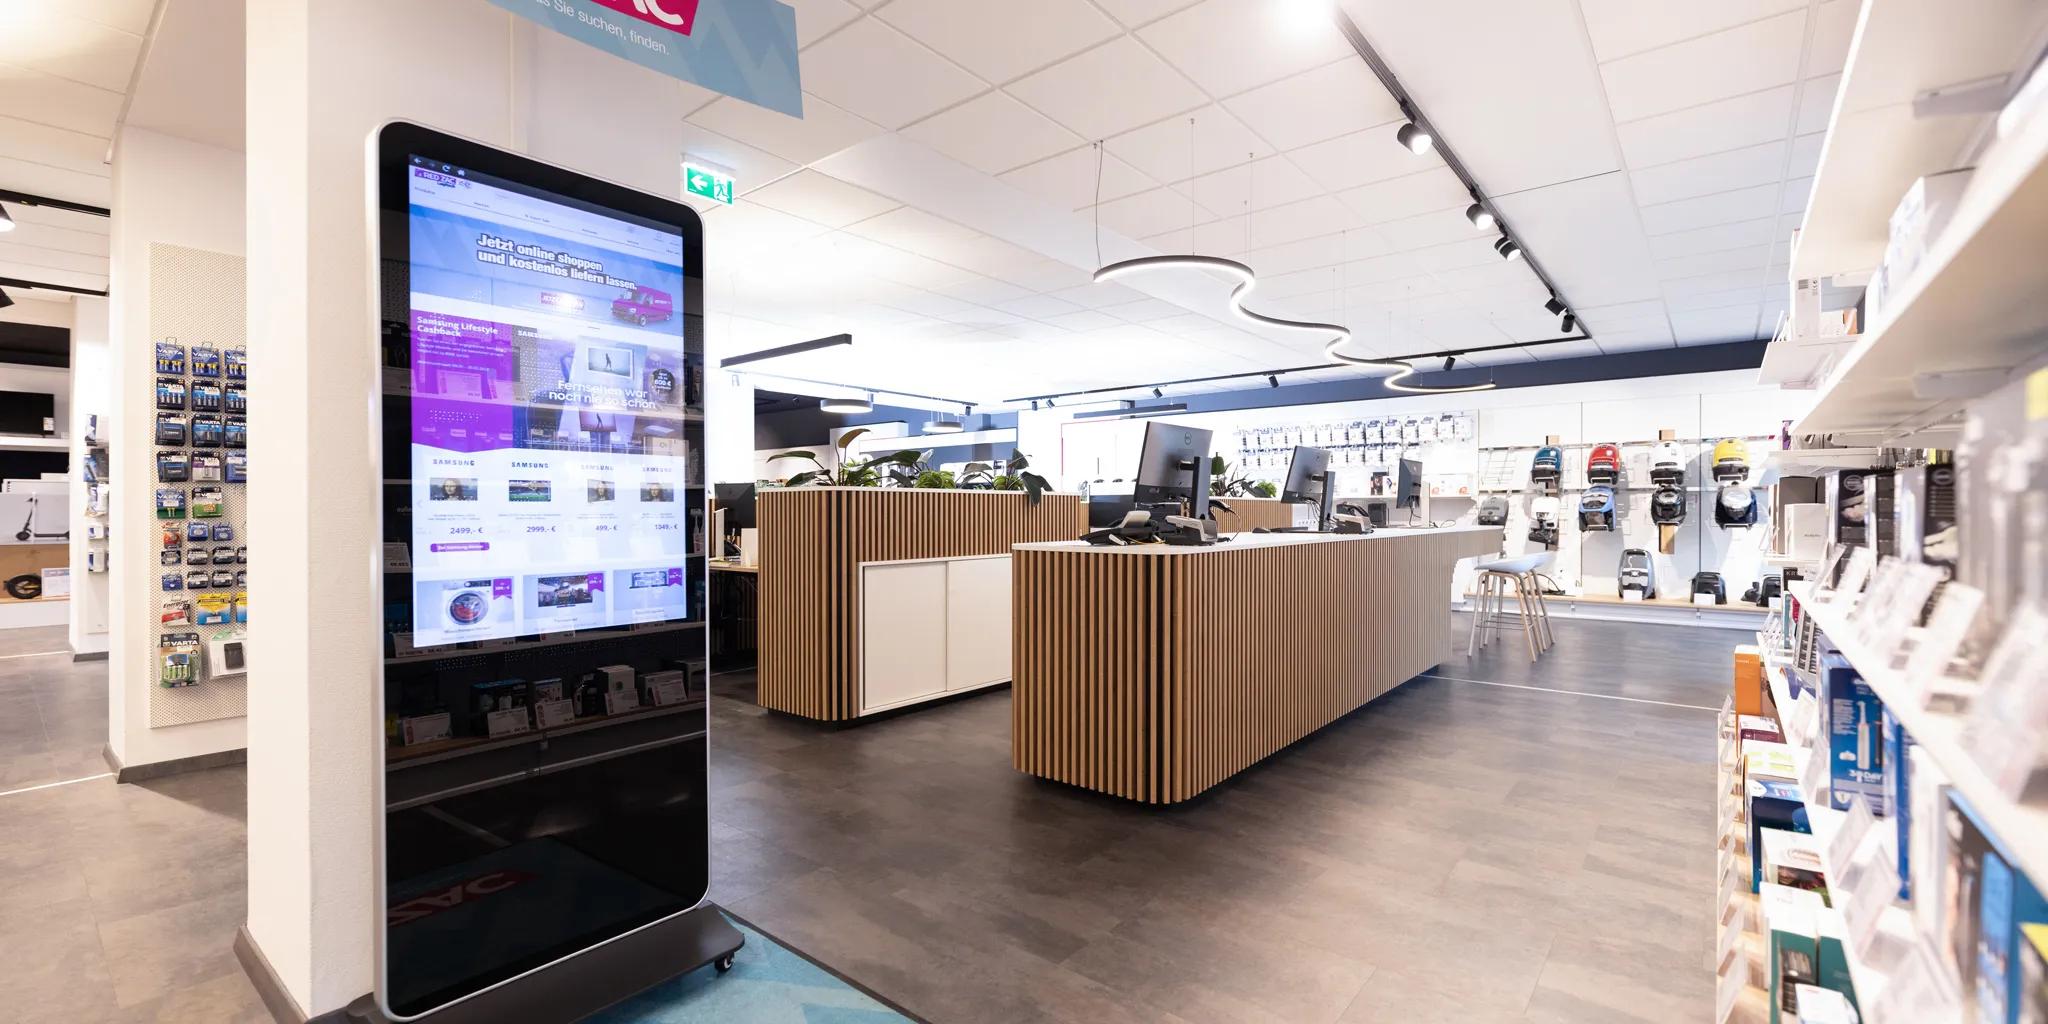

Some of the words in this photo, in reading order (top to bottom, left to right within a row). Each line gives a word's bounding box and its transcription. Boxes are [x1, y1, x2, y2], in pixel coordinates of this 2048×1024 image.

[554, 0, 575, 17] Sie
[578, 9, 627, 41] suchen,
[629, 29, 670, 55] finden.
[477, 234, 514, 252] Jetzt
[516, 244, 555, 261] online
[557, 253, 603, 272] shoppen
[478, 250, 506, 265] und
[509, 254, 569, 277] kostenlos
[570, 268, 604, 284] liefern
[605, 275, 638, 290] lassen.
[417, 316, 460, 330] Samsung
[461, 323, 498, 334] Lifestyle
[417, 325, 461, 337] Cashback
[558, 380, 622, 395] Fernsehen
[624, 388, 648, 398] war
[549, 391, 581, 402] noch
[584, 394, 601, 404] nie
[605, 397, 619, 406] so
[163, 600, 189, 608] Energizer
